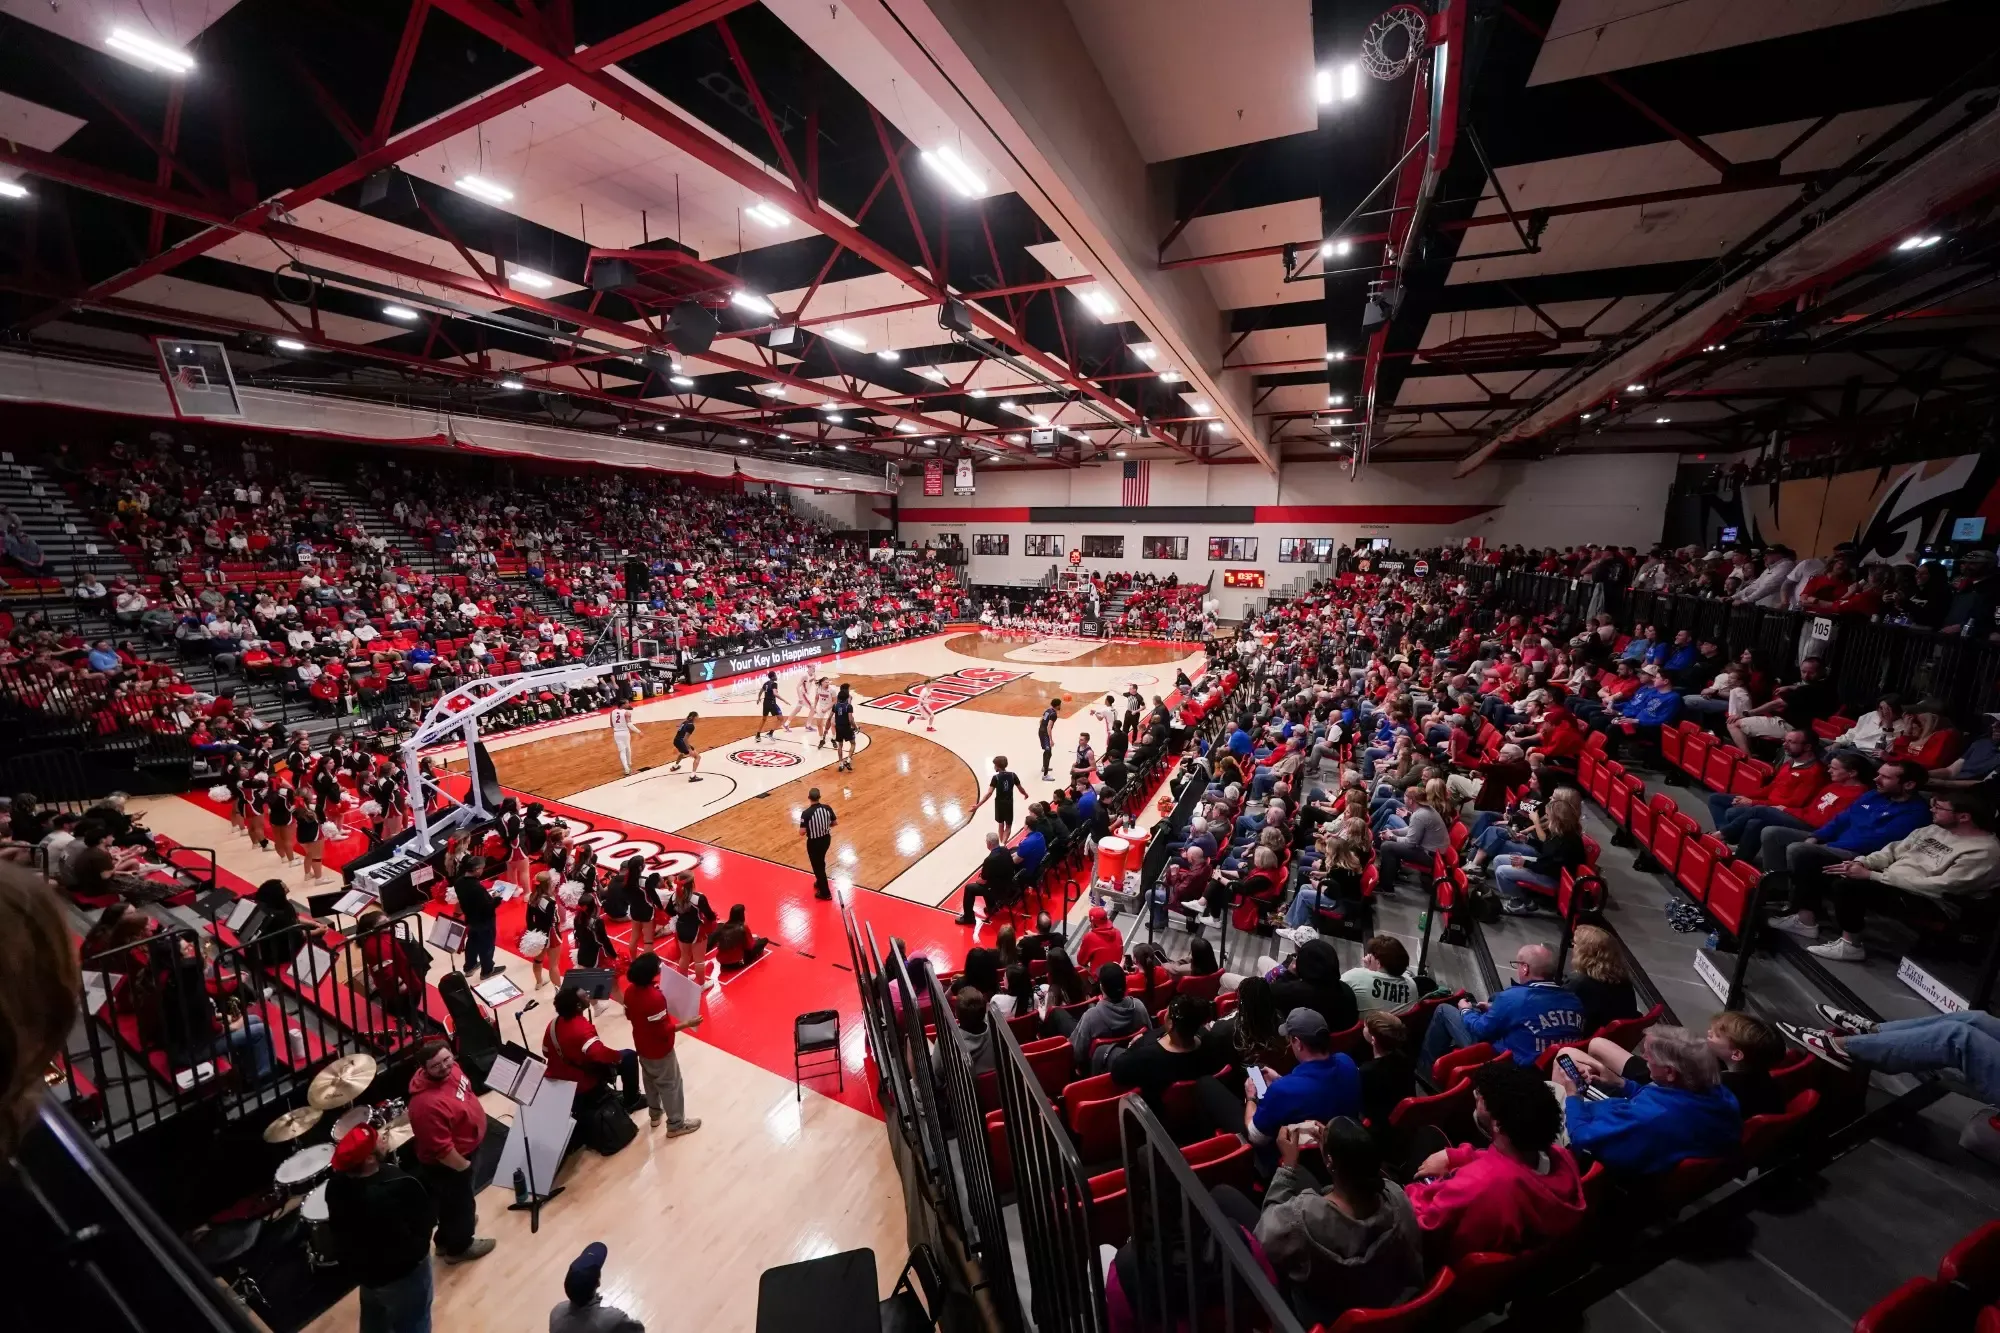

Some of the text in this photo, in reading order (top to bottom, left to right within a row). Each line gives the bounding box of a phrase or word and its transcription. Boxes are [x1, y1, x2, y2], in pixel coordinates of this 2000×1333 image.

[1814, 622, 1829, 636] 105
[621, 663, 643, 671] NUTRL
[730, 659, 753, 671] Your
[753, 654, 771, 667] Key
[782, 645, 821, 661] Happiness
[1906, 964, 1924, 981] First
[1372, 979, 1409, 1003] STAFF
[1899, 963, 1964, 1013] Community ARE
[1524, 1010, 1585, 1034] EASTER
